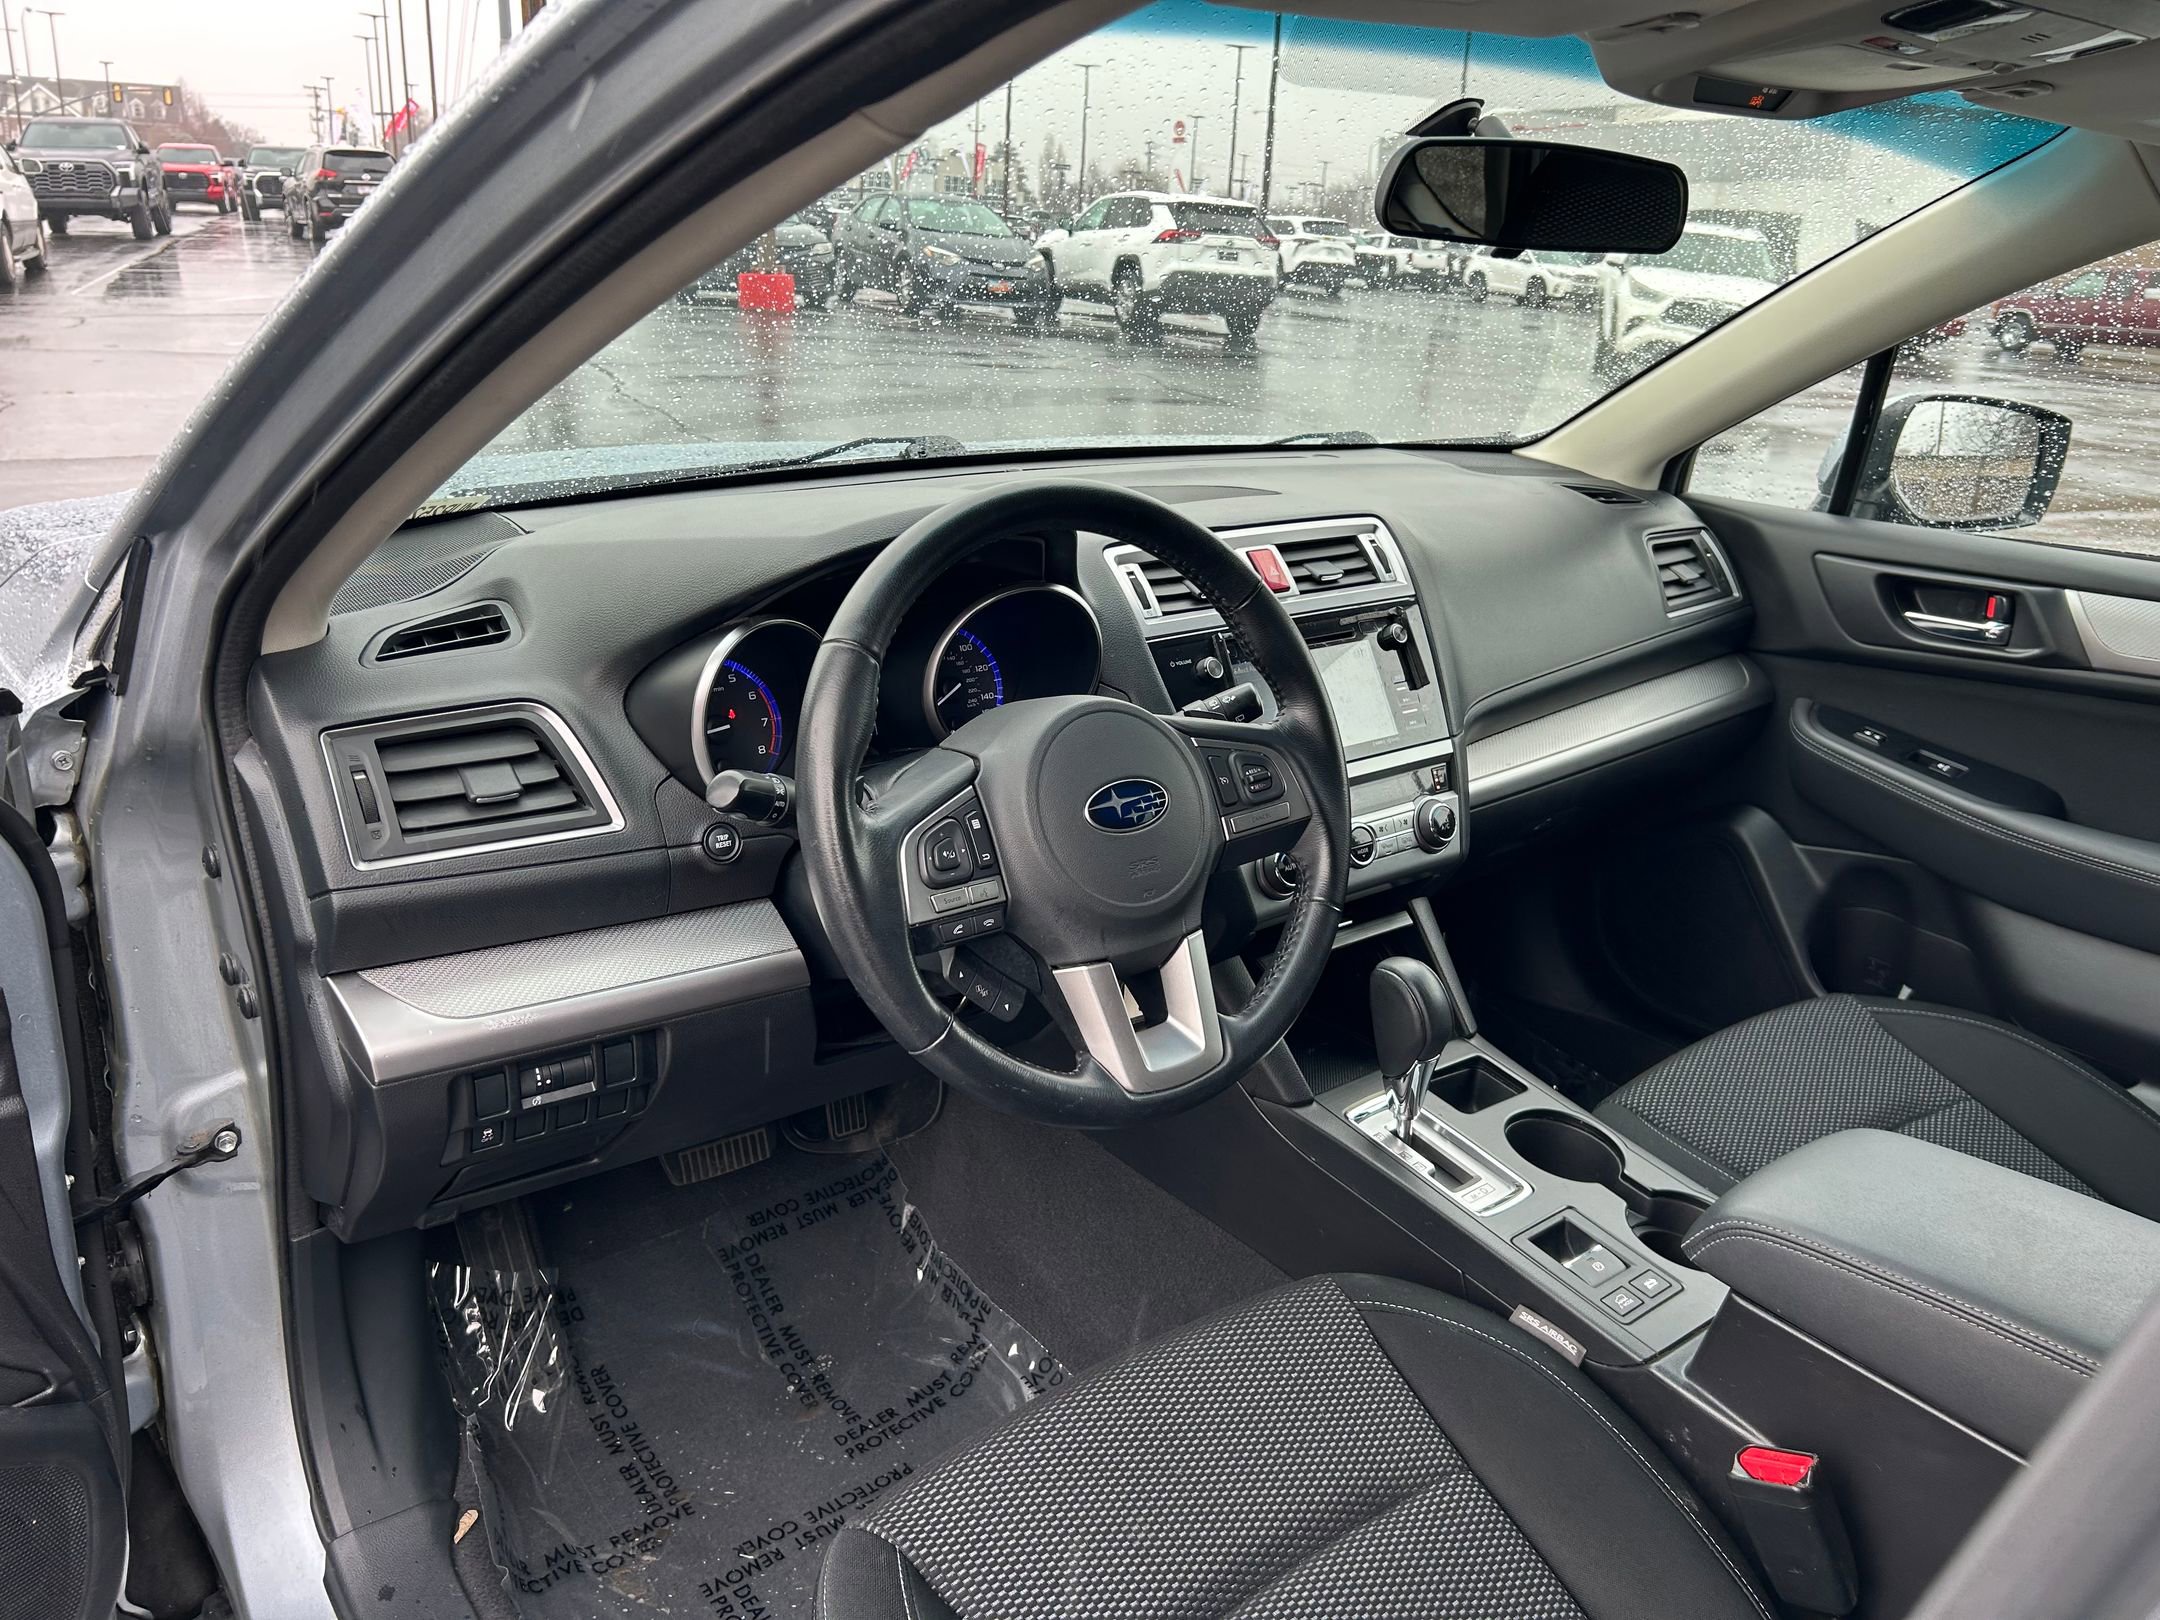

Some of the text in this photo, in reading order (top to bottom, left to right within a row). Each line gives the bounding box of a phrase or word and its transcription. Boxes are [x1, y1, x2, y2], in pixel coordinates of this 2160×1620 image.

[960, 643, 973, 652] 100
[975, 664, 989, 673] 120
[727, 673, 737, 683] 5
[748, 691, 758, 701] 6
[980, 691, 995, 701] 140
[760, 717, 769, 728] 7
[757, 745, 767, 755] 8
[715, 840, 732, 849] RESET
[716, 834, 729, 842] TRIP
[747, 1153, 889, 1228] PROTECTIVE COVER
[718, 1167, 899, 1262] DEALER MUST REMOVE
[726, 1261, 819, 1410] PROTECTIVE COVER
[745, 1254, 861, 1424] DEALER MUST REMOVE
[1519, 1312, 1578, 1354] SRS AIRBAG
[834, 1407, 899, 1446] DEALER
[906, 1370, 952, 1407] MUST
[845, 1397, 946, 1459] PROTECTIVE
[589, 1413, 625, 1456] MUST
[591, 1364, 686, 1507] PROTECTIVE COVER
[619, 1463, 663, 1515] DEALER
[733, 1462, 914, 1555] PROTECTIVE COVER
[543, 1543, 598, 1568] MUST
[609, 1502, 696, 1548] REMOVE
[699, 1514, 845, 1597] MUST REMOVE
